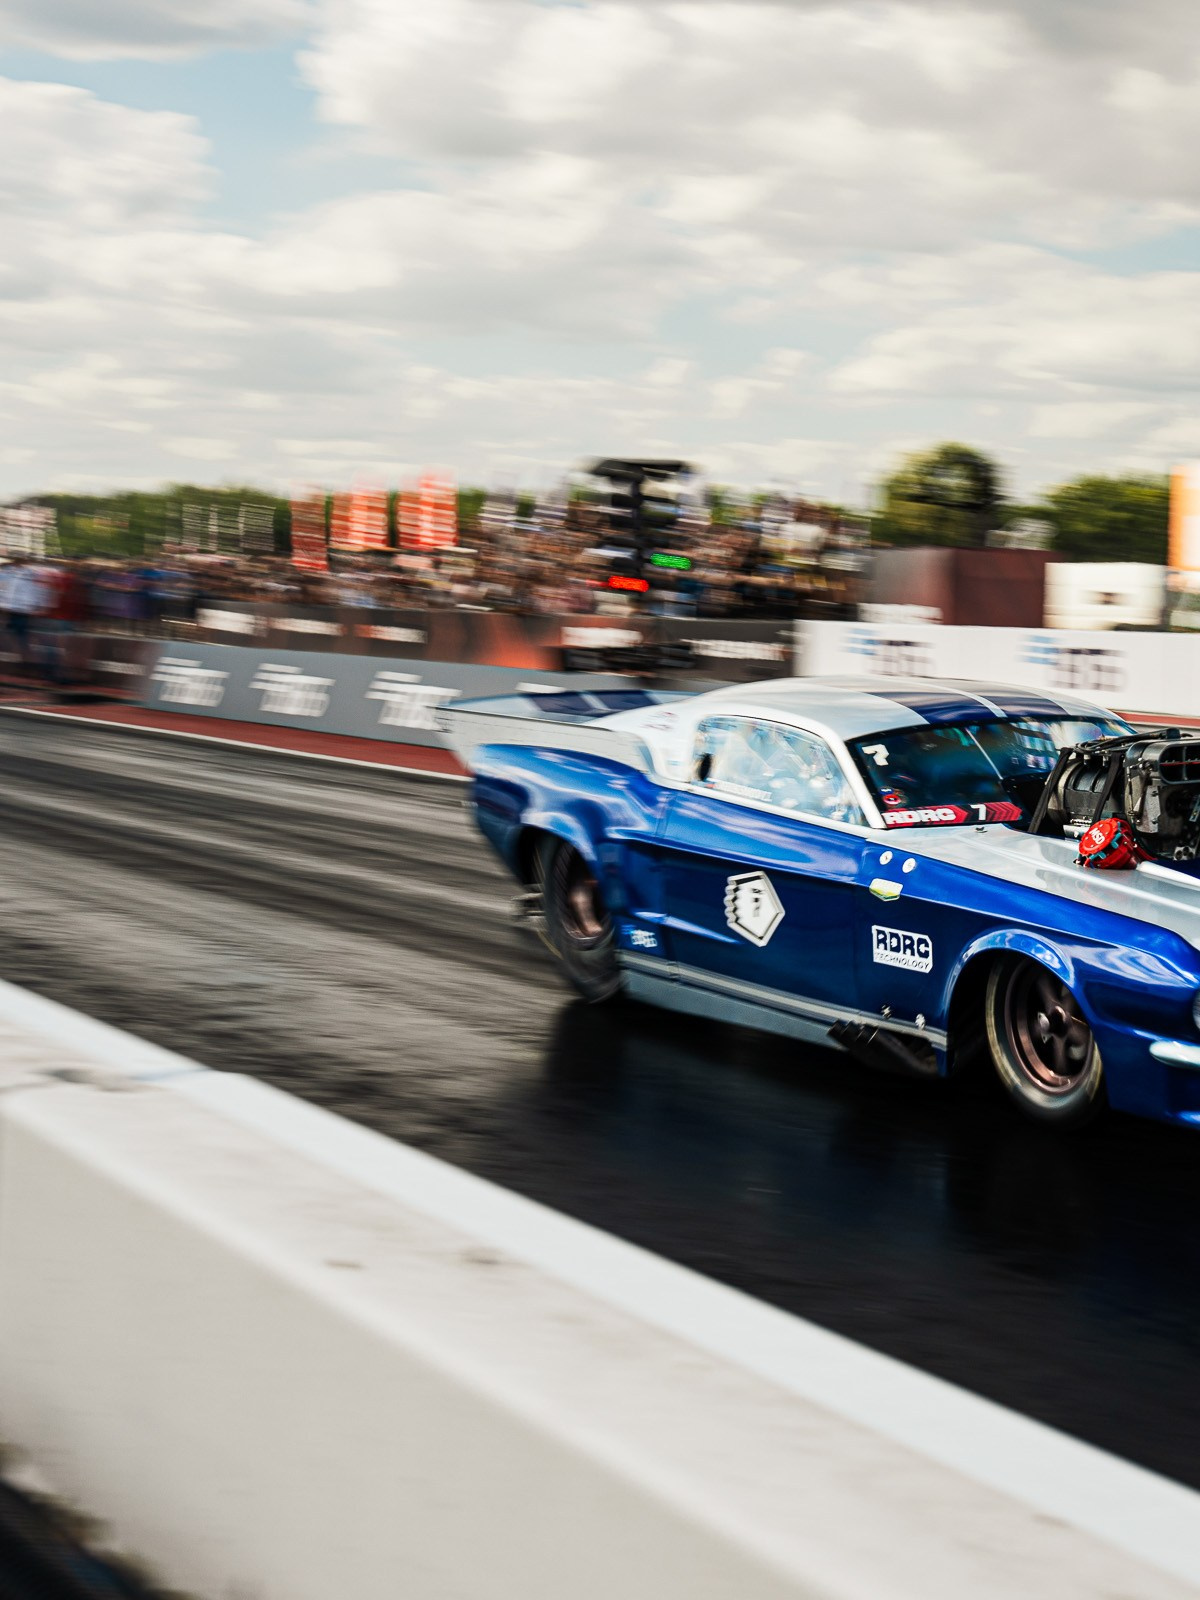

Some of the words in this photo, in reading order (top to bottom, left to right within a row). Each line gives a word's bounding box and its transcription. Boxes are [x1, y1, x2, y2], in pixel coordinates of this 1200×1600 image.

[861, 743, 890, 766] 7
[881, 807, 957, 825] RDRC
[970, 803, 987, 821] 7
[1089, 827, 1106, 845] MSD
[875, 928, 930, 959] RDRC
[874, 952, 930, 970] TECHNOLOGY
